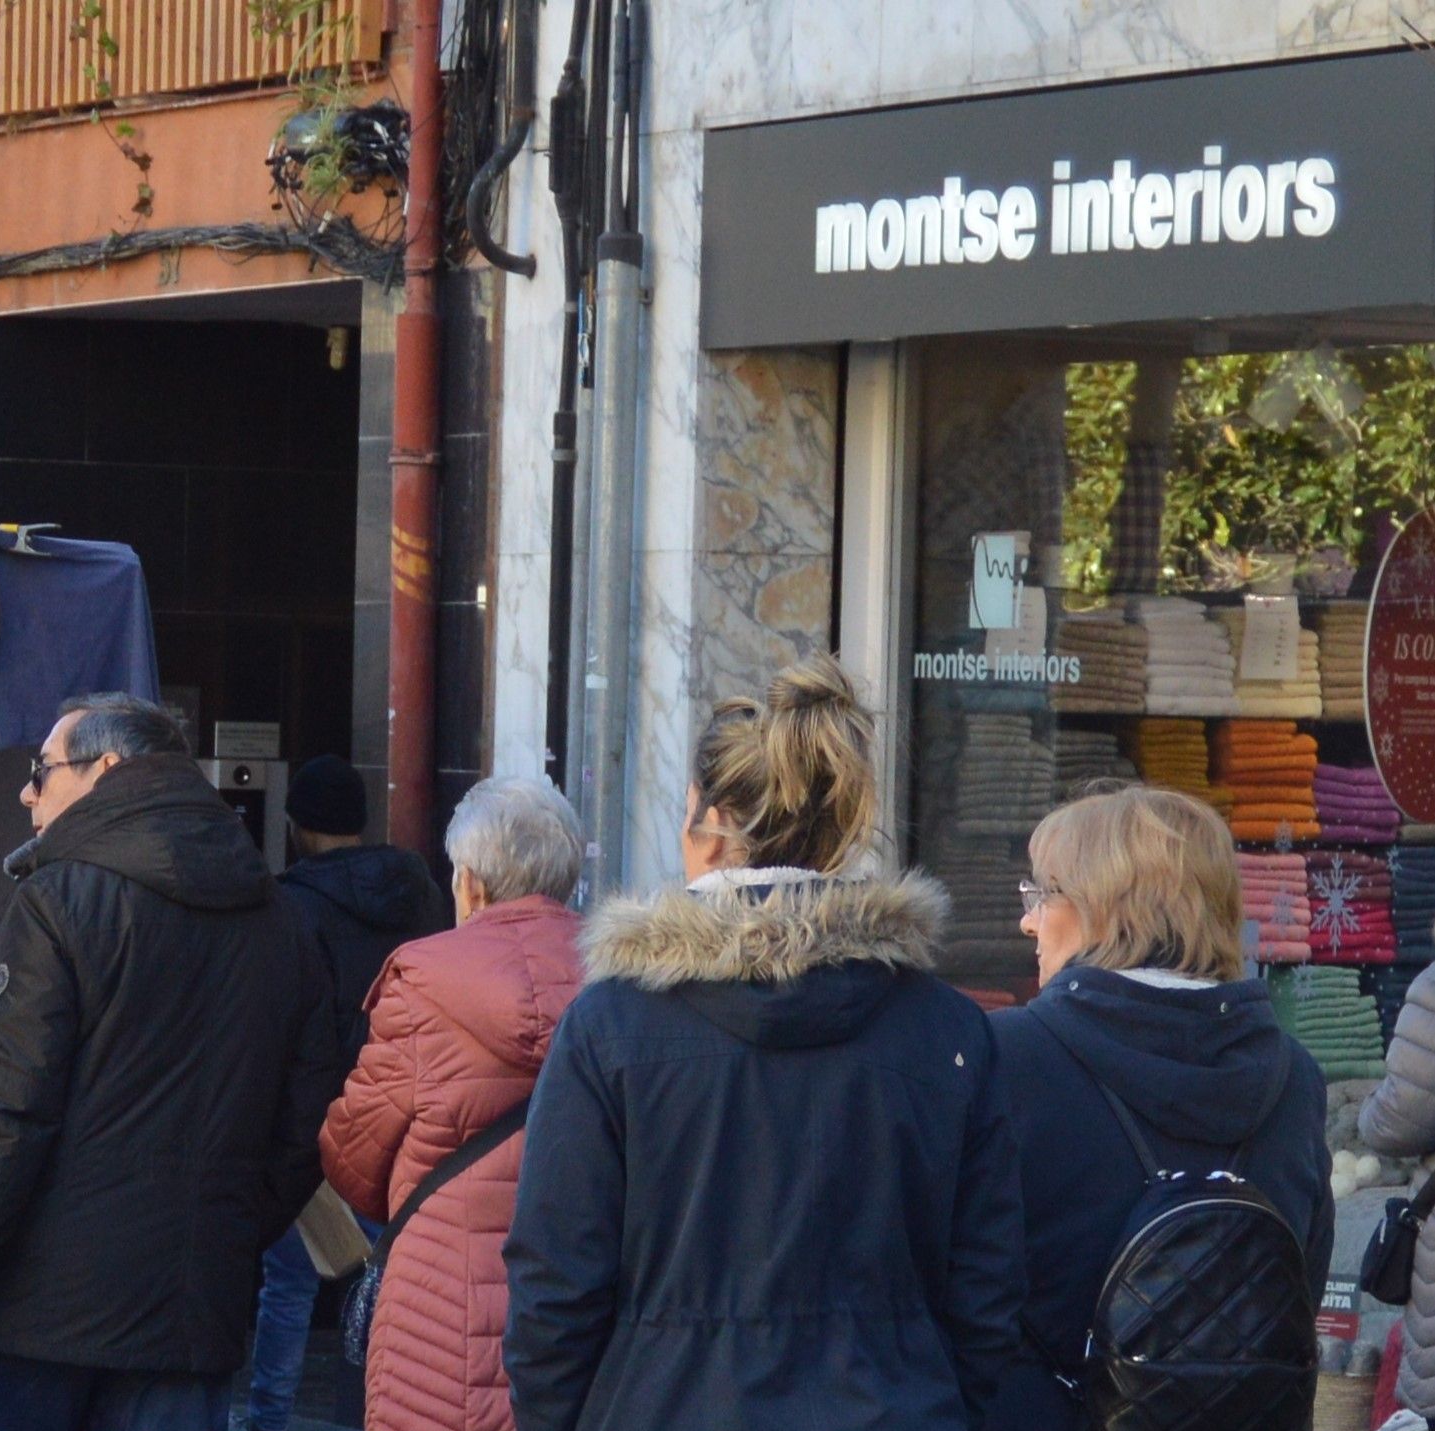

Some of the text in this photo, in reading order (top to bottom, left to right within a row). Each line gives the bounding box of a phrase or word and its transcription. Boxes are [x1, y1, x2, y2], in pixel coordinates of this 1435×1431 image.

[815, 145, 1336, 273] montse interiors
[1413, 633, 1435, 661] CO
[914, 648, 1081, 684] montse interiors
